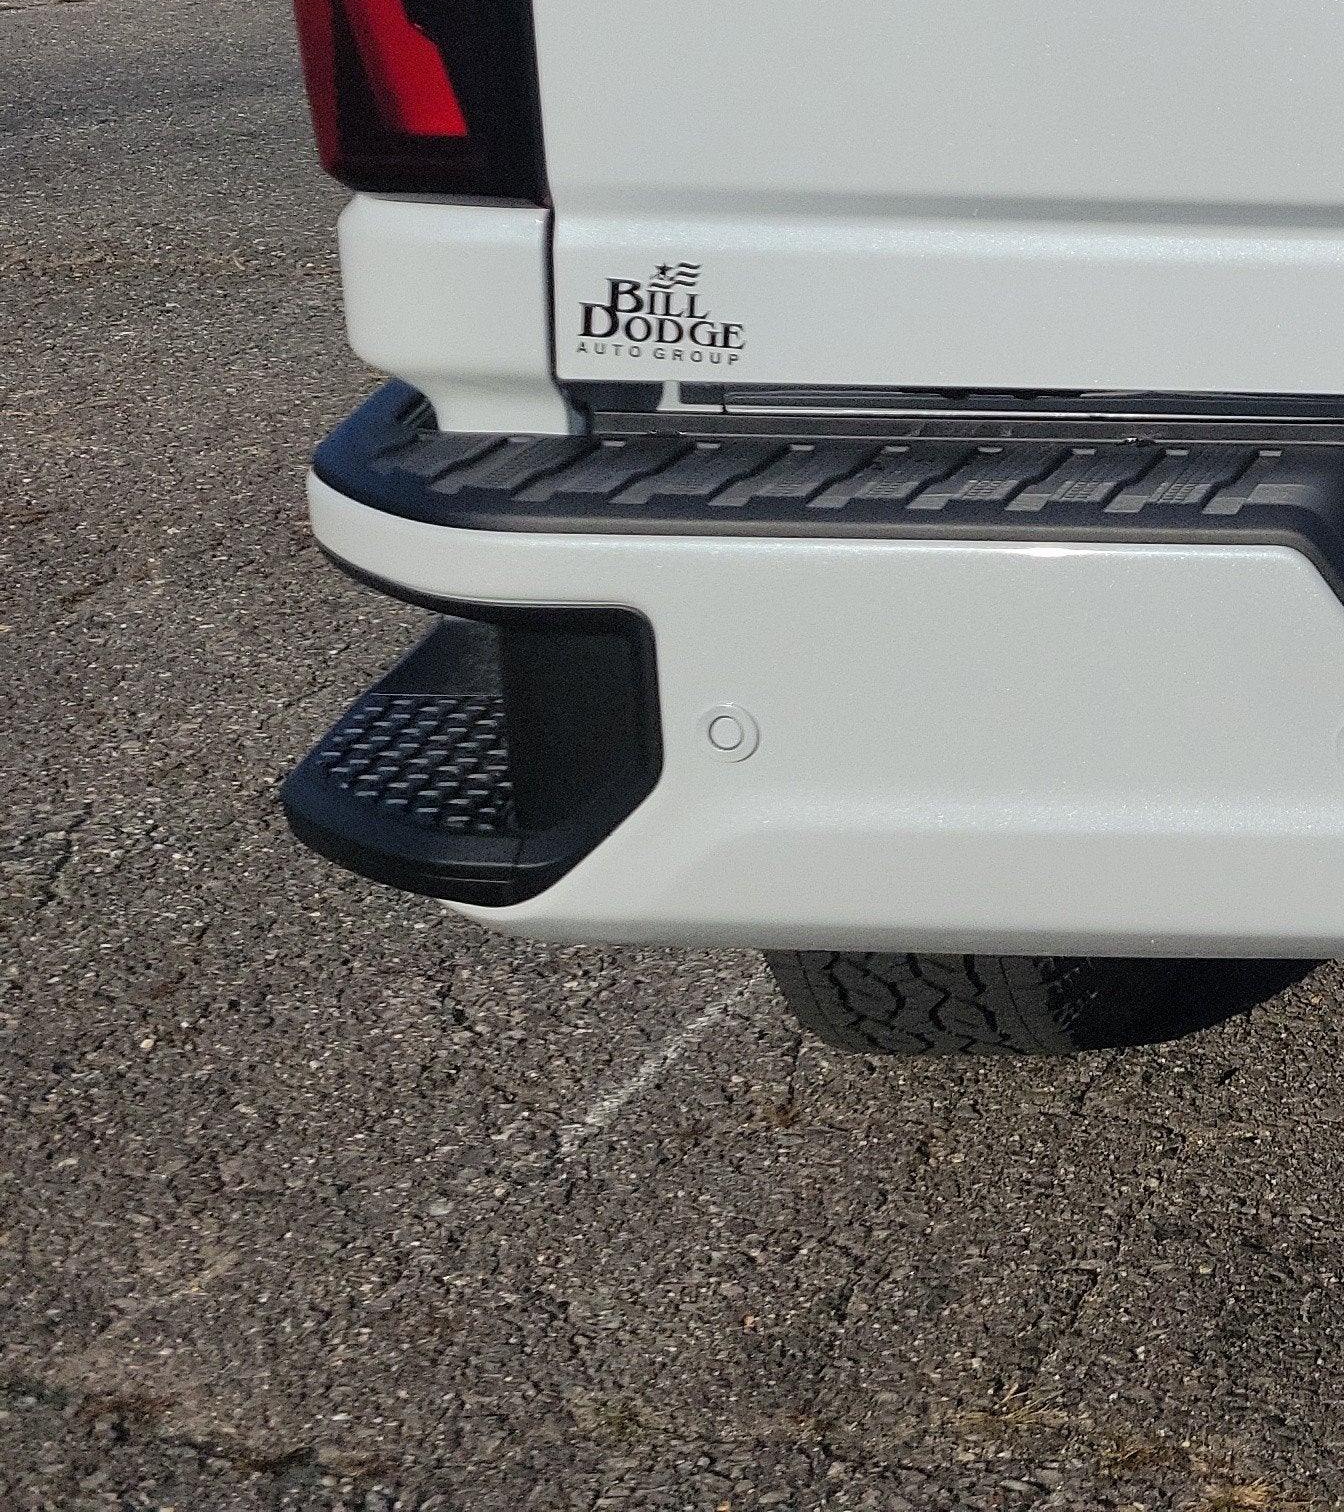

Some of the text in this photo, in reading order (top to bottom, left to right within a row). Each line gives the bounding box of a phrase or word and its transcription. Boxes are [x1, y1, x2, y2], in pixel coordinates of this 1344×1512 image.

[607, 277, 710, 319] BILL
[577, 301, 747, 349] DODGE
[576, 341, 740, 366] AUTO GROUP
